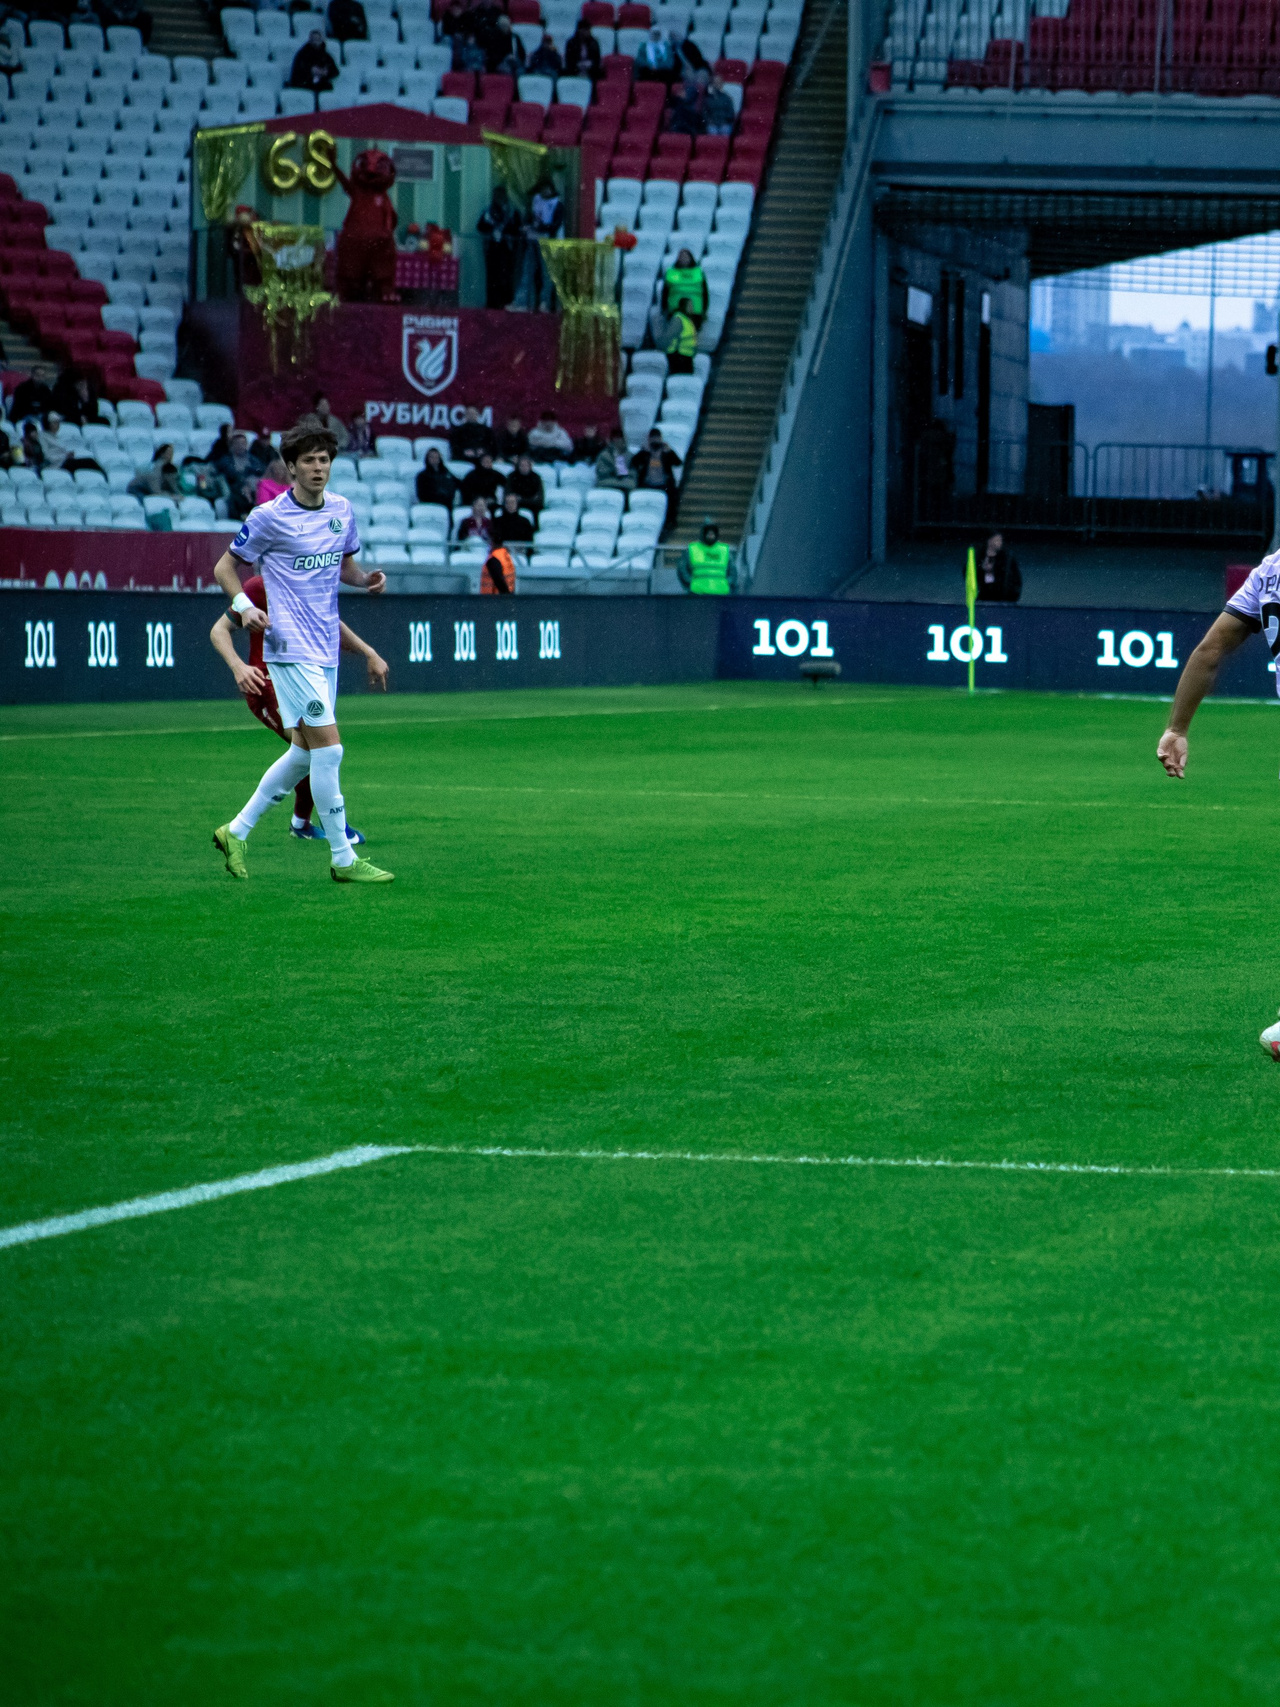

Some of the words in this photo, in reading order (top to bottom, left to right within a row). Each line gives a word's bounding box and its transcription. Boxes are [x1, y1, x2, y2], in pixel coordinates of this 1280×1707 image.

[25, 621, 57, 668] 101
[88, 621, 119, 667] 101
[146, 622, 175, 668] 101
[409, 621, 433, 663] 101
[454, 620, 477, 662] 101
[495, 620, 519, 661] 101
[539, 620, 562, 660] 101
[752, 619, 835, 658] 101
[926, 624, 1009, 663] 101
[1096, 629, 1180, 668] 101
